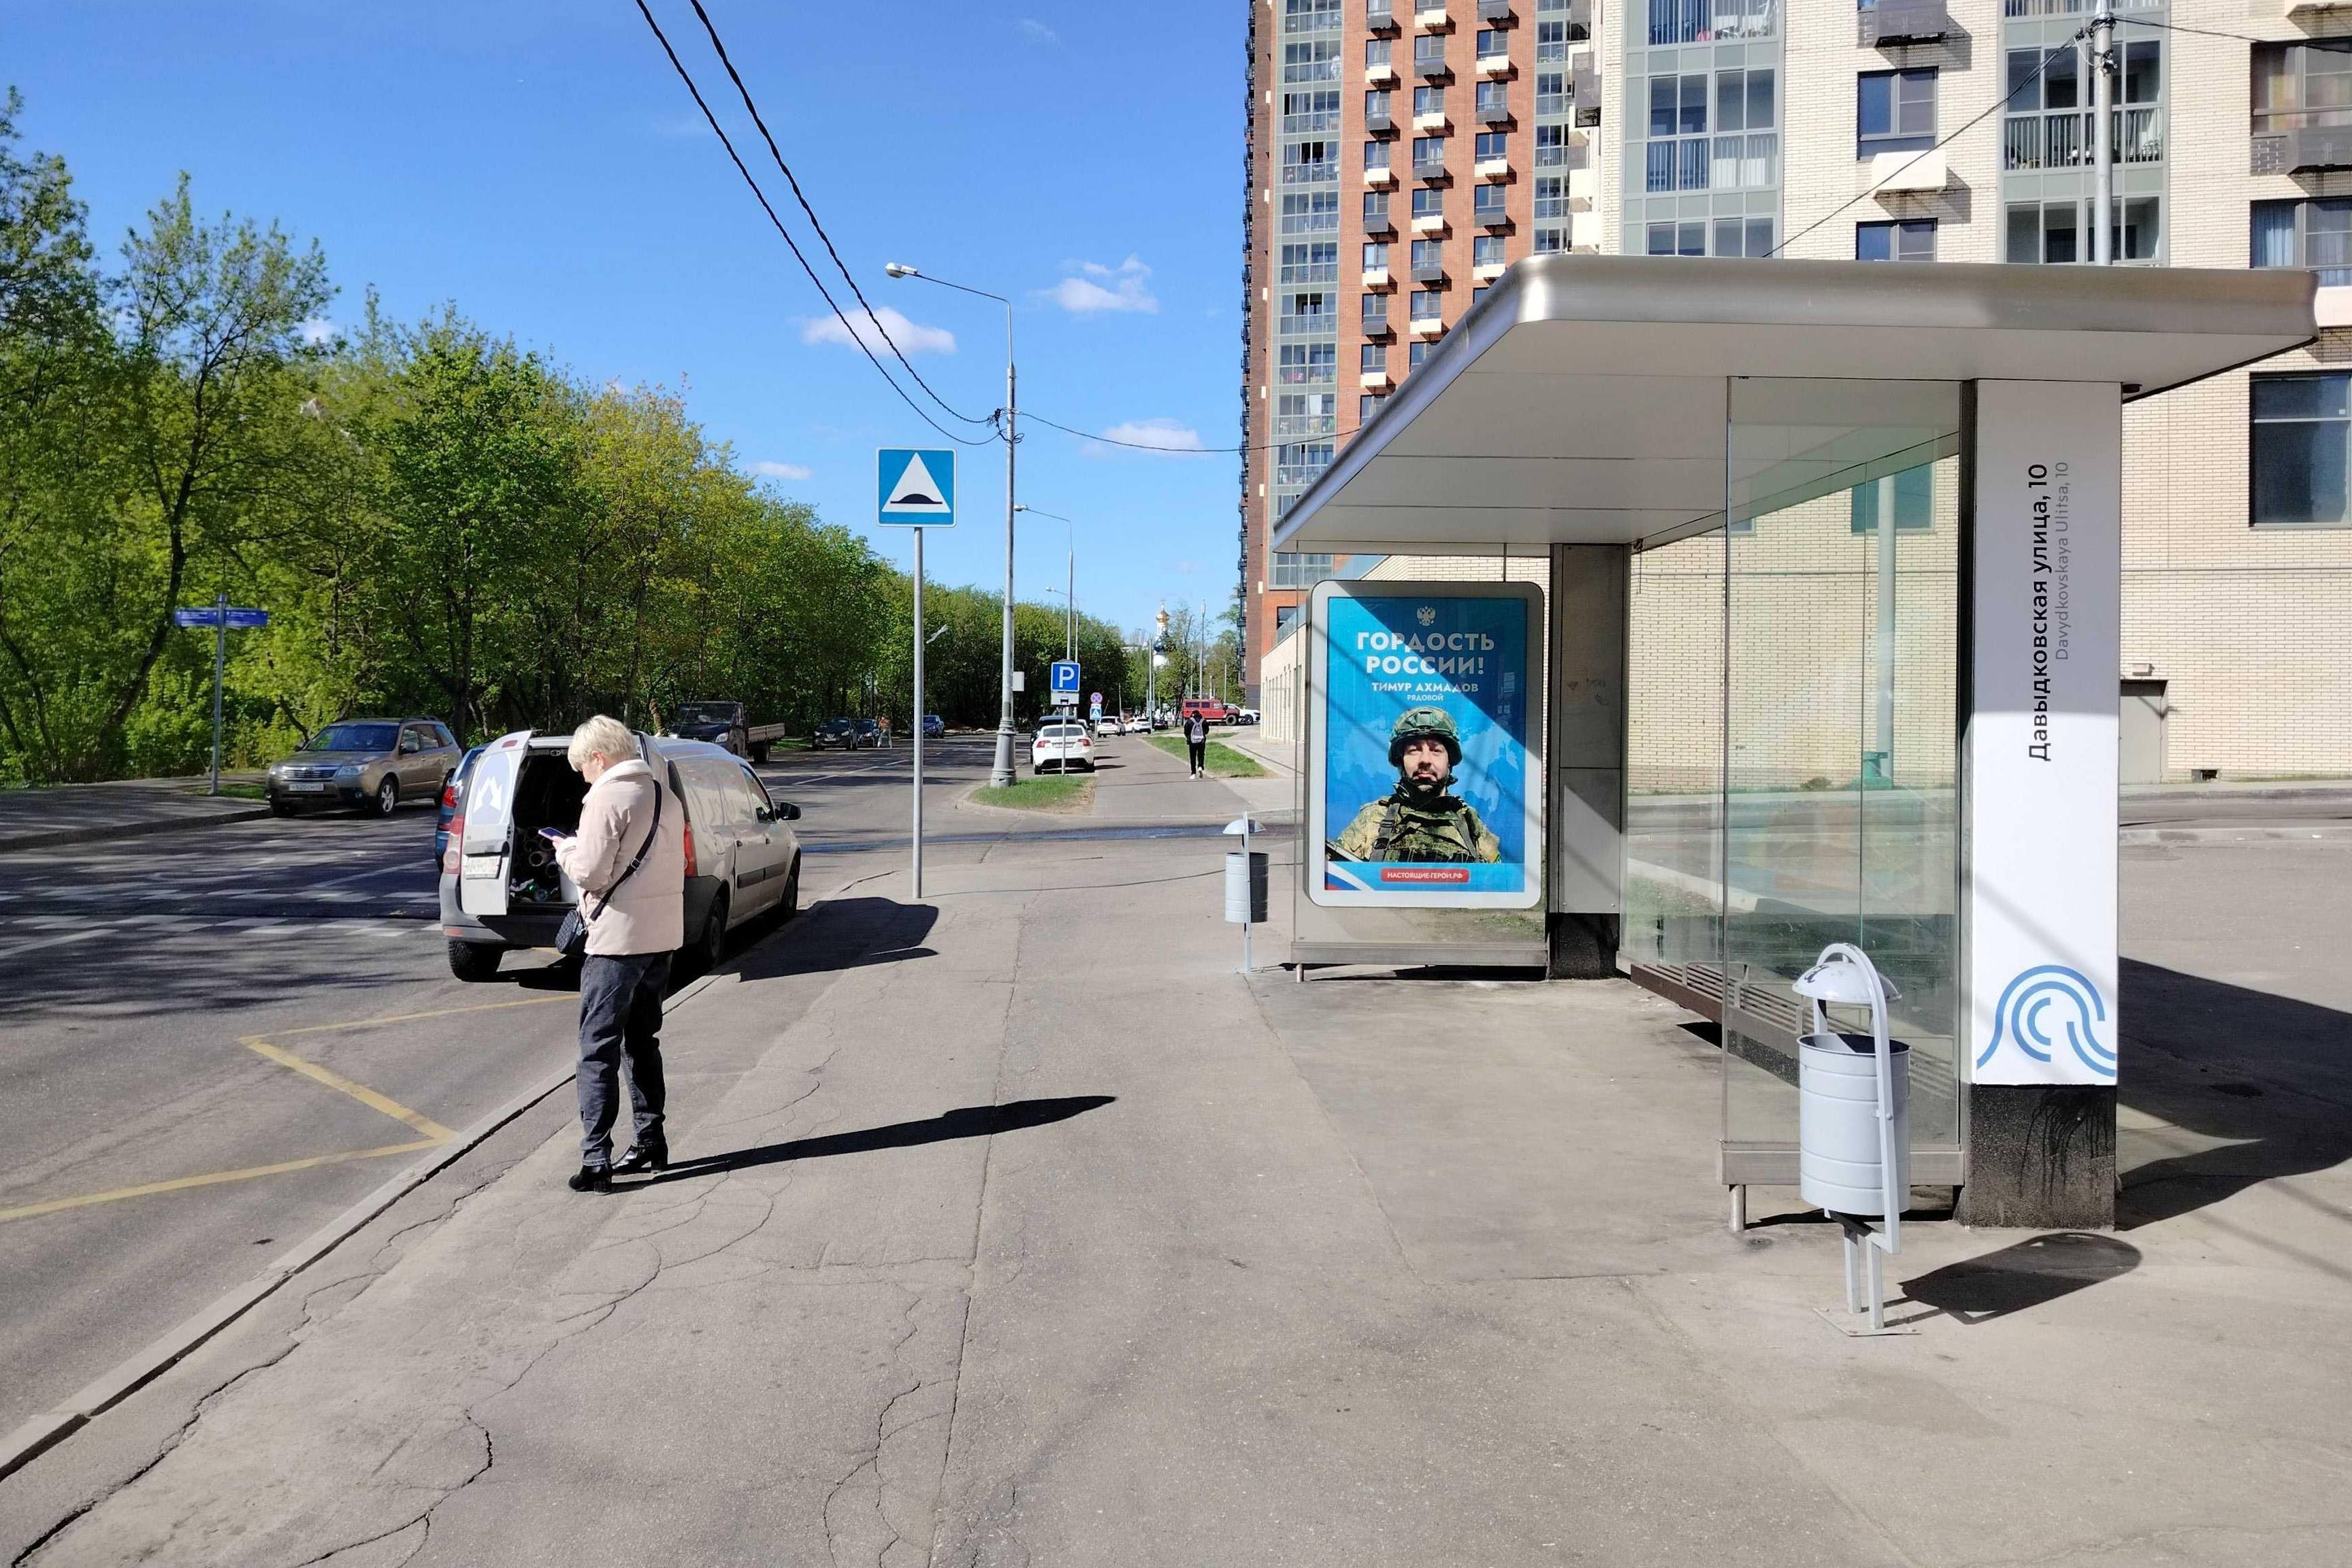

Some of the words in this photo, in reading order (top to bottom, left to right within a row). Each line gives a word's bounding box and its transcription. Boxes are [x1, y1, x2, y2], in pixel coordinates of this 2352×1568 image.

[2028, 463, 2048, 488] 10
[2055, 461, 2068, 478] 10
[2055, 482, 2070, 532] Ulitsa,
[2033, 494, 2053, 574] улица,
[2055, 538, 2072, 660] Davydkovskaya
[1357, 632, 1494, 653] ГОРДОСТЬ
[1367, 655, 1484, 675] РОССИИ!
[2029, 580, 2051, 762] Давыдковская
[1059, 666, 1075, 687] P
[1372, 682, 1411, 691] ТИМУР
[1416, 683, 1479, 693] АХМАДОВ
[1407, 693, 1443, 702] РЯДОВОЙ
